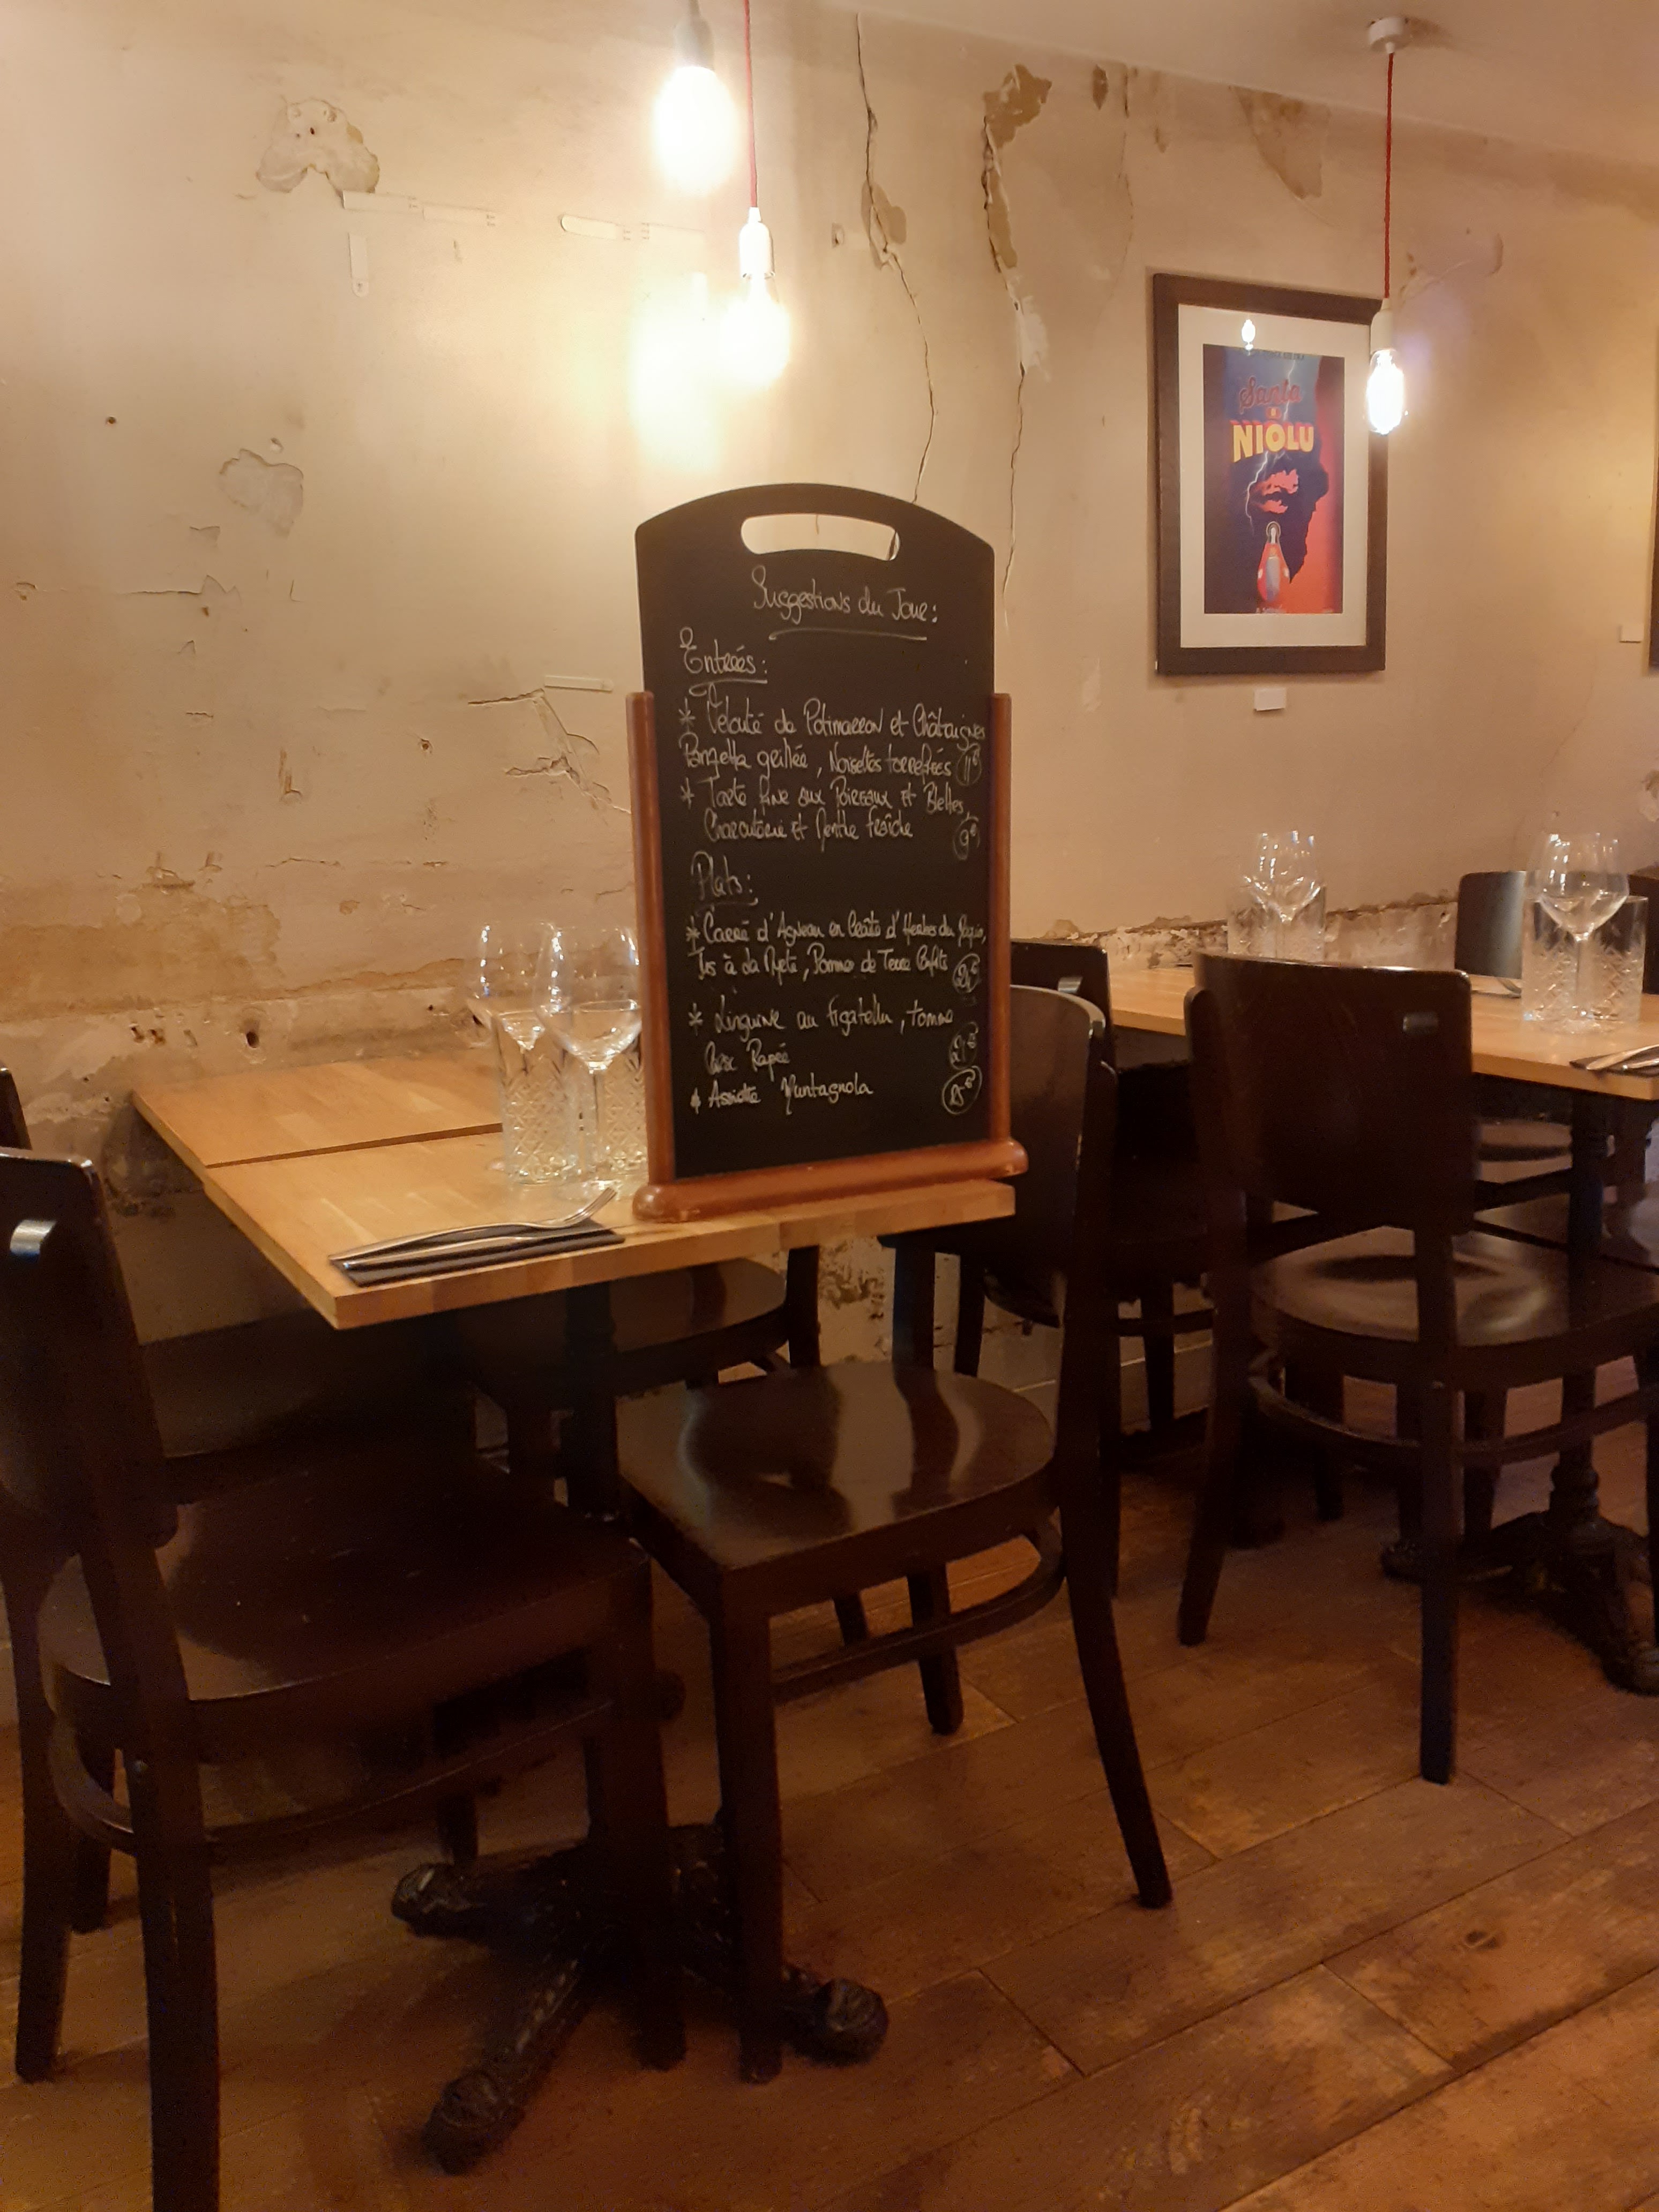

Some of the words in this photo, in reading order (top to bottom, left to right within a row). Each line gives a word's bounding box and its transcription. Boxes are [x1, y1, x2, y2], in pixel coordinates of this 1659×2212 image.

[1232, 421, 1314, 463] NIOLU
[752, 565, 851, 625] Suggestions
[858, 586, 884, 617] du
[775, 708, 797, 735] de
[804, 698, 883, 737] Potimarron
[890, 709, 909, 738] et
[725, 952, 738, 976] à
[796, 1011, 819, 1030] au
